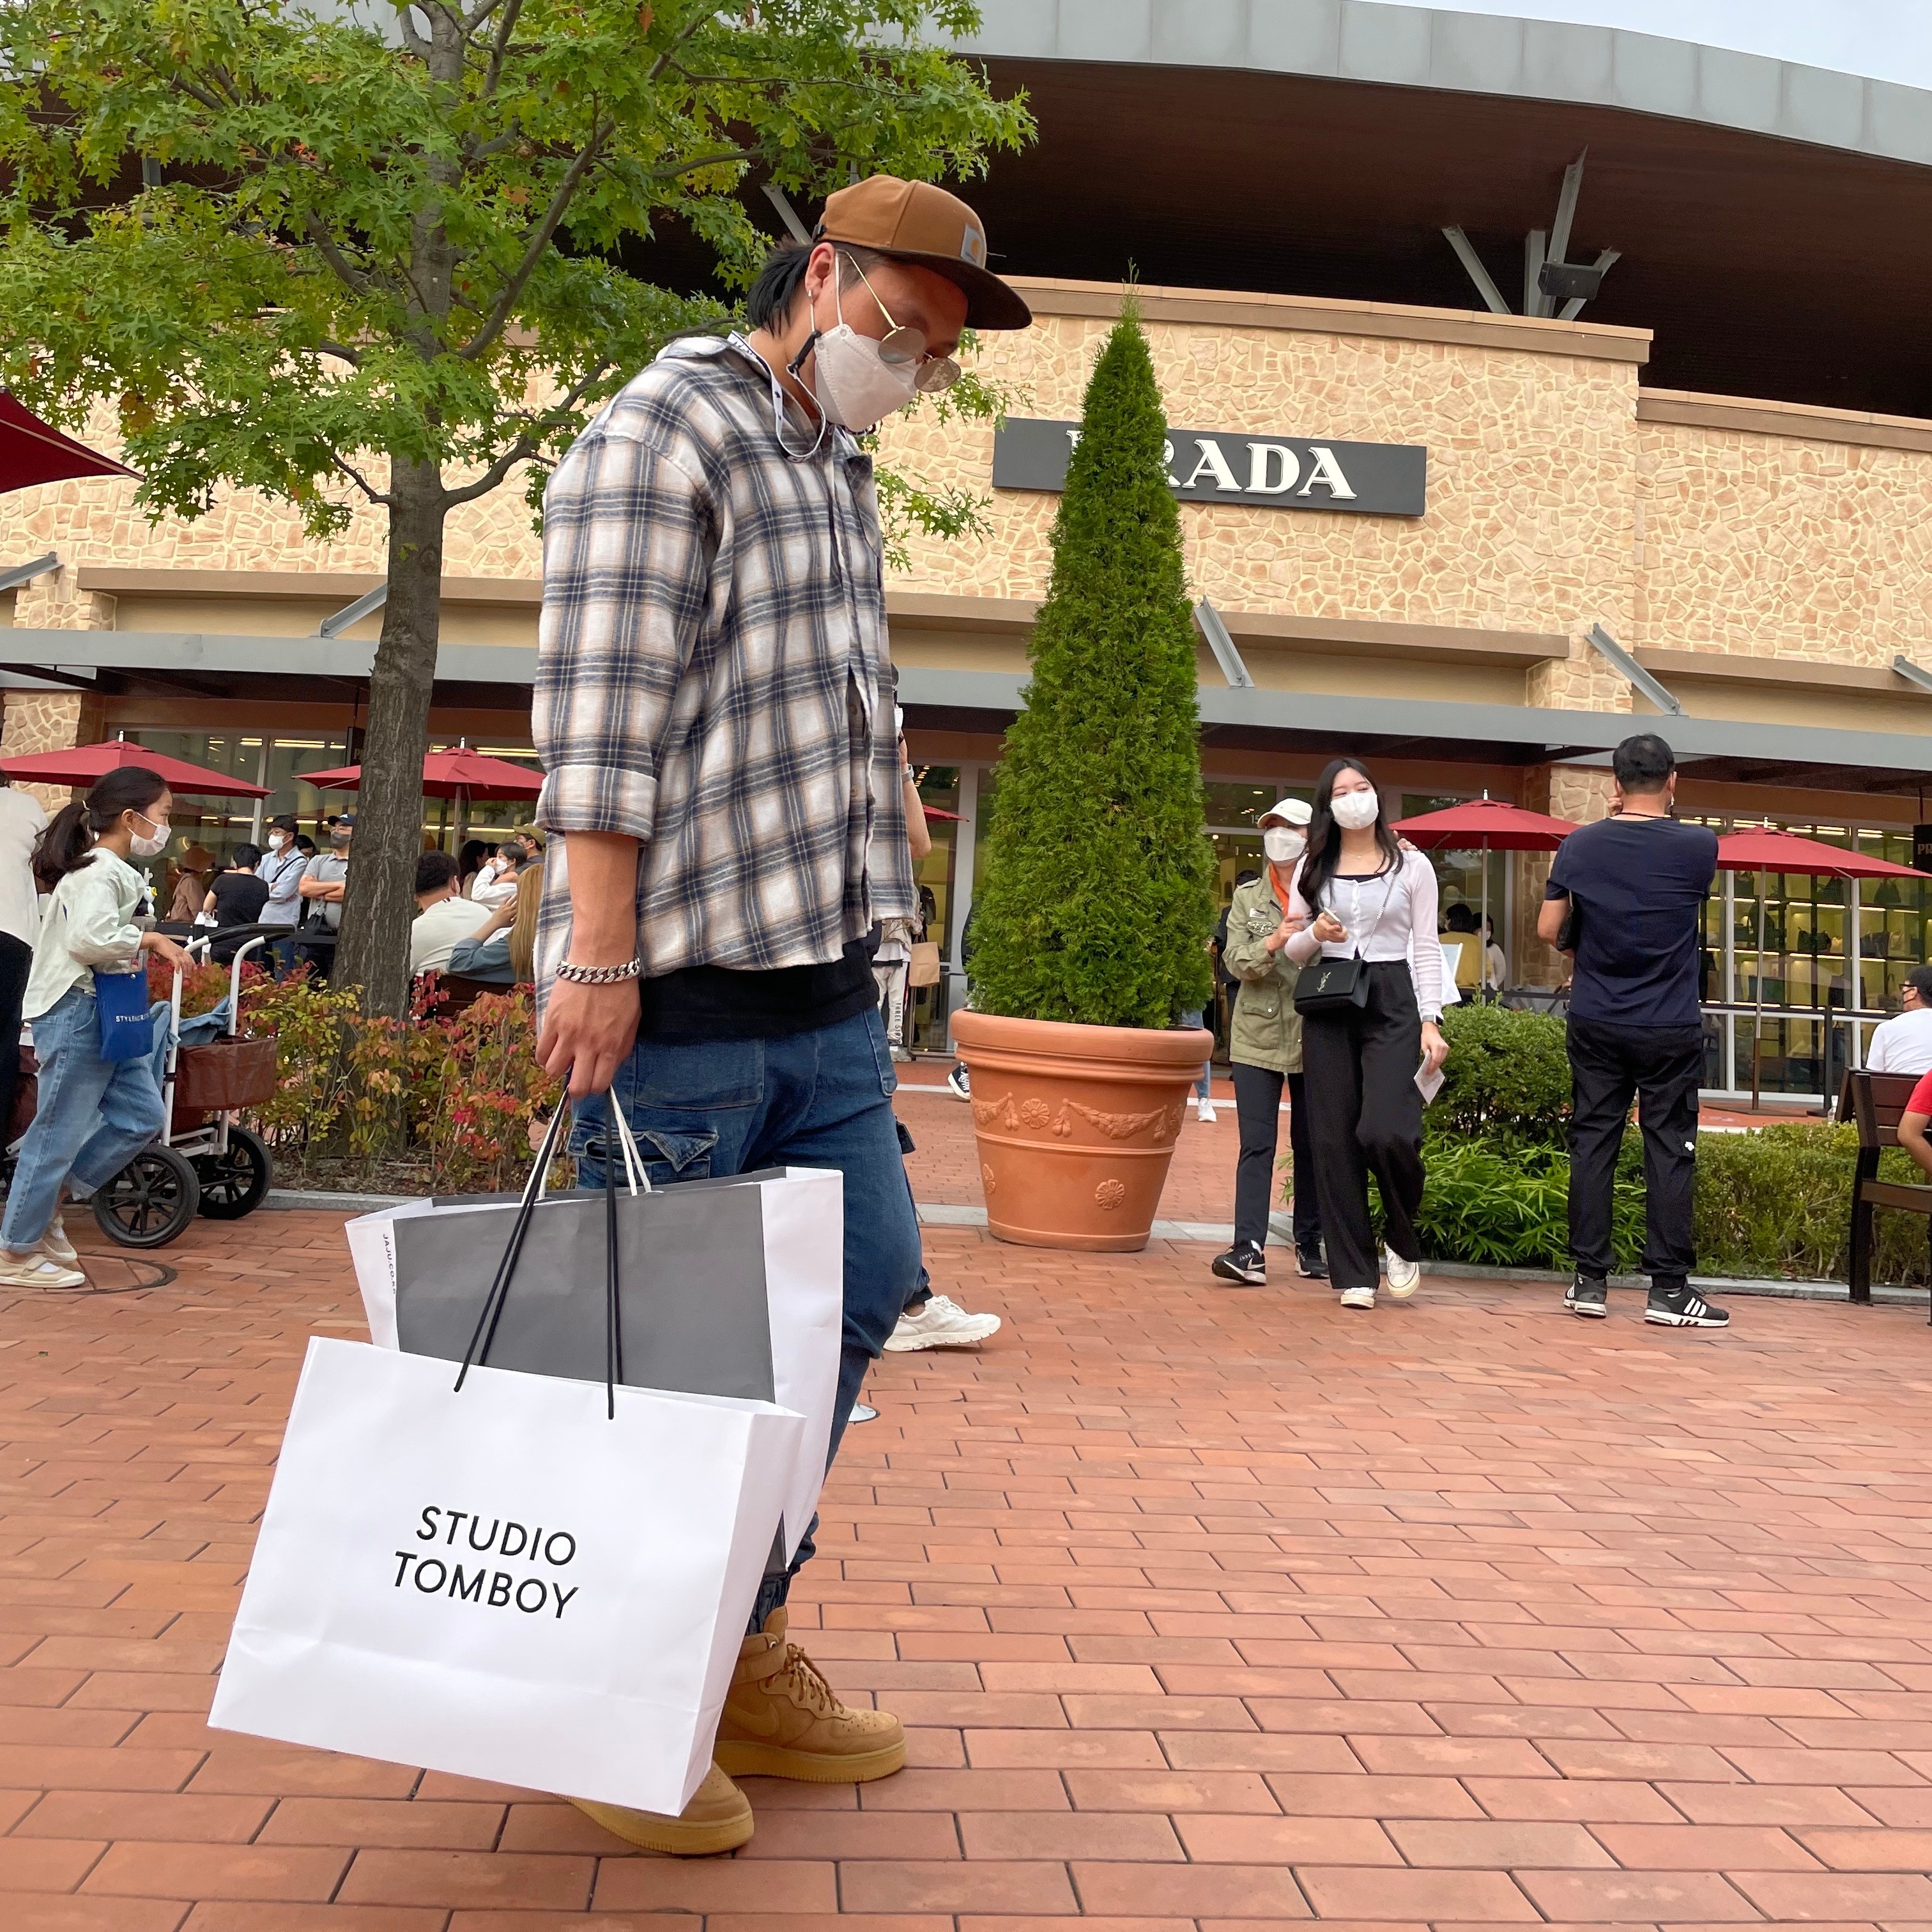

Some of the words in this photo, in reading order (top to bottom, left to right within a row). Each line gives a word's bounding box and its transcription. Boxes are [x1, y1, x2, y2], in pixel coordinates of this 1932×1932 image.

[1066, 429, 1358, 499] ADA
[416, 1505, 576, 1566] STUDIO
[395, 1551, 579, 1619] TOMBOY
